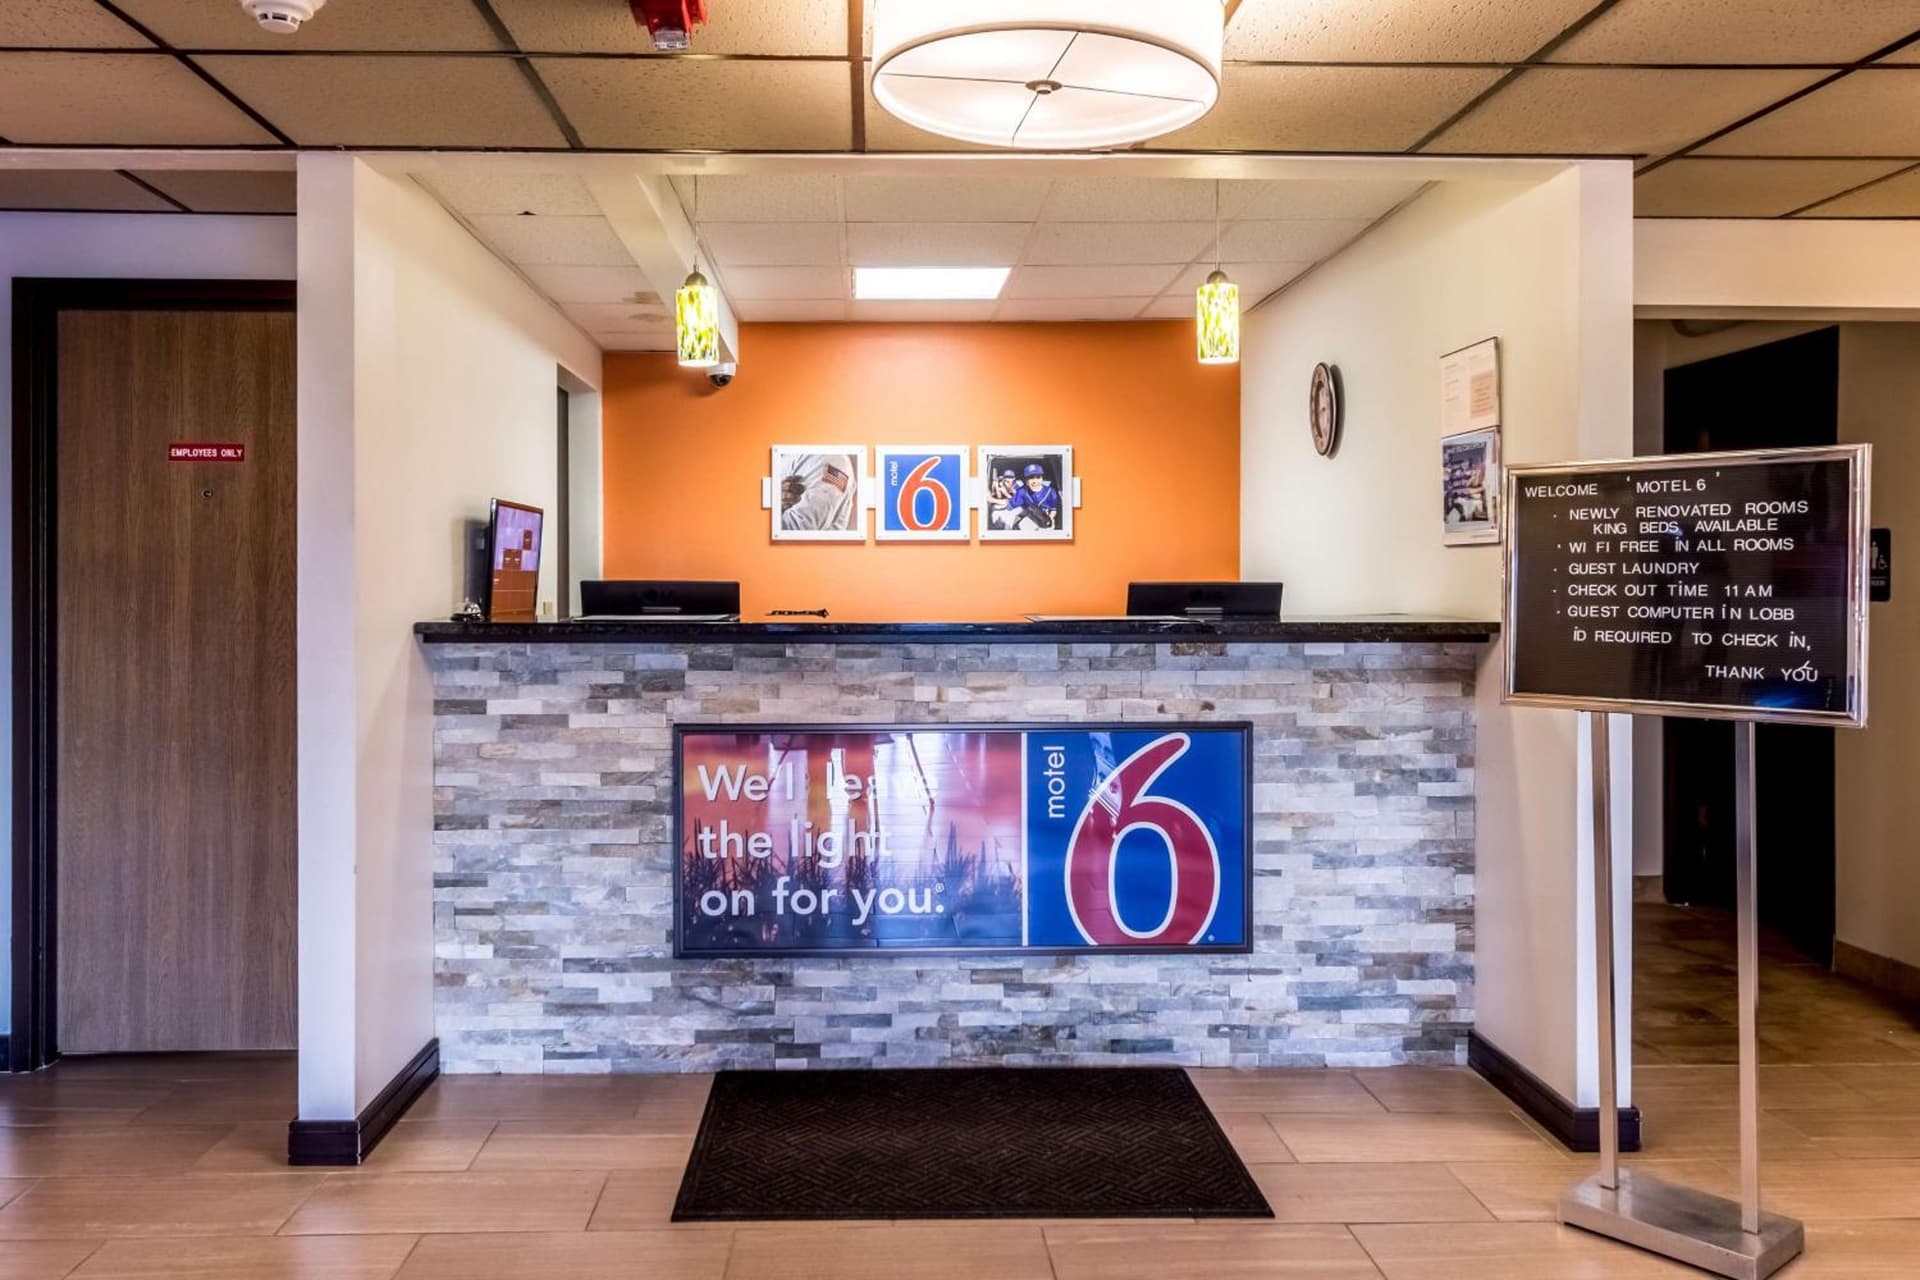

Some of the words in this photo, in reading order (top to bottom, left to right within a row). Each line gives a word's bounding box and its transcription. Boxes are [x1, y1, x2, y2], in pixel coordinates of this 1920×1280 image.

[171, 448, 217, 457] EMPLOYEES
[221, 448, 243, 457] ONLY
[897, 456, 952, 531] 6
[1525, 484, 1598, 497] WELCOME
[1637, 480, 1691, 493] MOTEL
[1697, 479, 1706, 491] 6
[1570, 508, 1619, 520] NEWLY
[1636, 504, 1731, 517] RENOVATED
[1746, 501, 1808, 514] ROOMS
[1593, 523, 1627, 534] KING
[1640, 521, 1679, 534] BEDS
[1695, 519, 1777, 532] AVAILABLE
[1569, 542, 1586, 553] WI
[1597, 542, 1609, 552] FI
[1620, 541, 1658, 552] FREE
[1697, 540, 1725, 551] ALL
[1734, 538, 1793, 551] ROOMS
[1569, 563, 1616, 574] GUEST
[1623, 563, 1699, 574] LAUNDRY
[1568, 584, 1616, 596] CHECK
[1625, 585, 1656, 596] OUT
[1725, 585, 1737, 596] 11
[1745, 585, 1772, 596] AM
[1568, 605, 1619, 617] GUEST
[1628, 606, 1714, 619] COMPUTER
[1750, 608, 1794, 620] LOBB
[1595, 631, 1671, 643] REQUIRED
[1692, 633, 1712, 644] TO
[1722, 633, 1777, 647] CHECK
[1706, 665, 1764, 679] THANK
[698, 819, 773, 859] the
[791, 819, 893, 868] light
[1044, 745, 1065, 819] motel
[1065, 732, 1221, 946] 6
[700, 882, 755, 916] on
[773, 876, 833, 916] for
